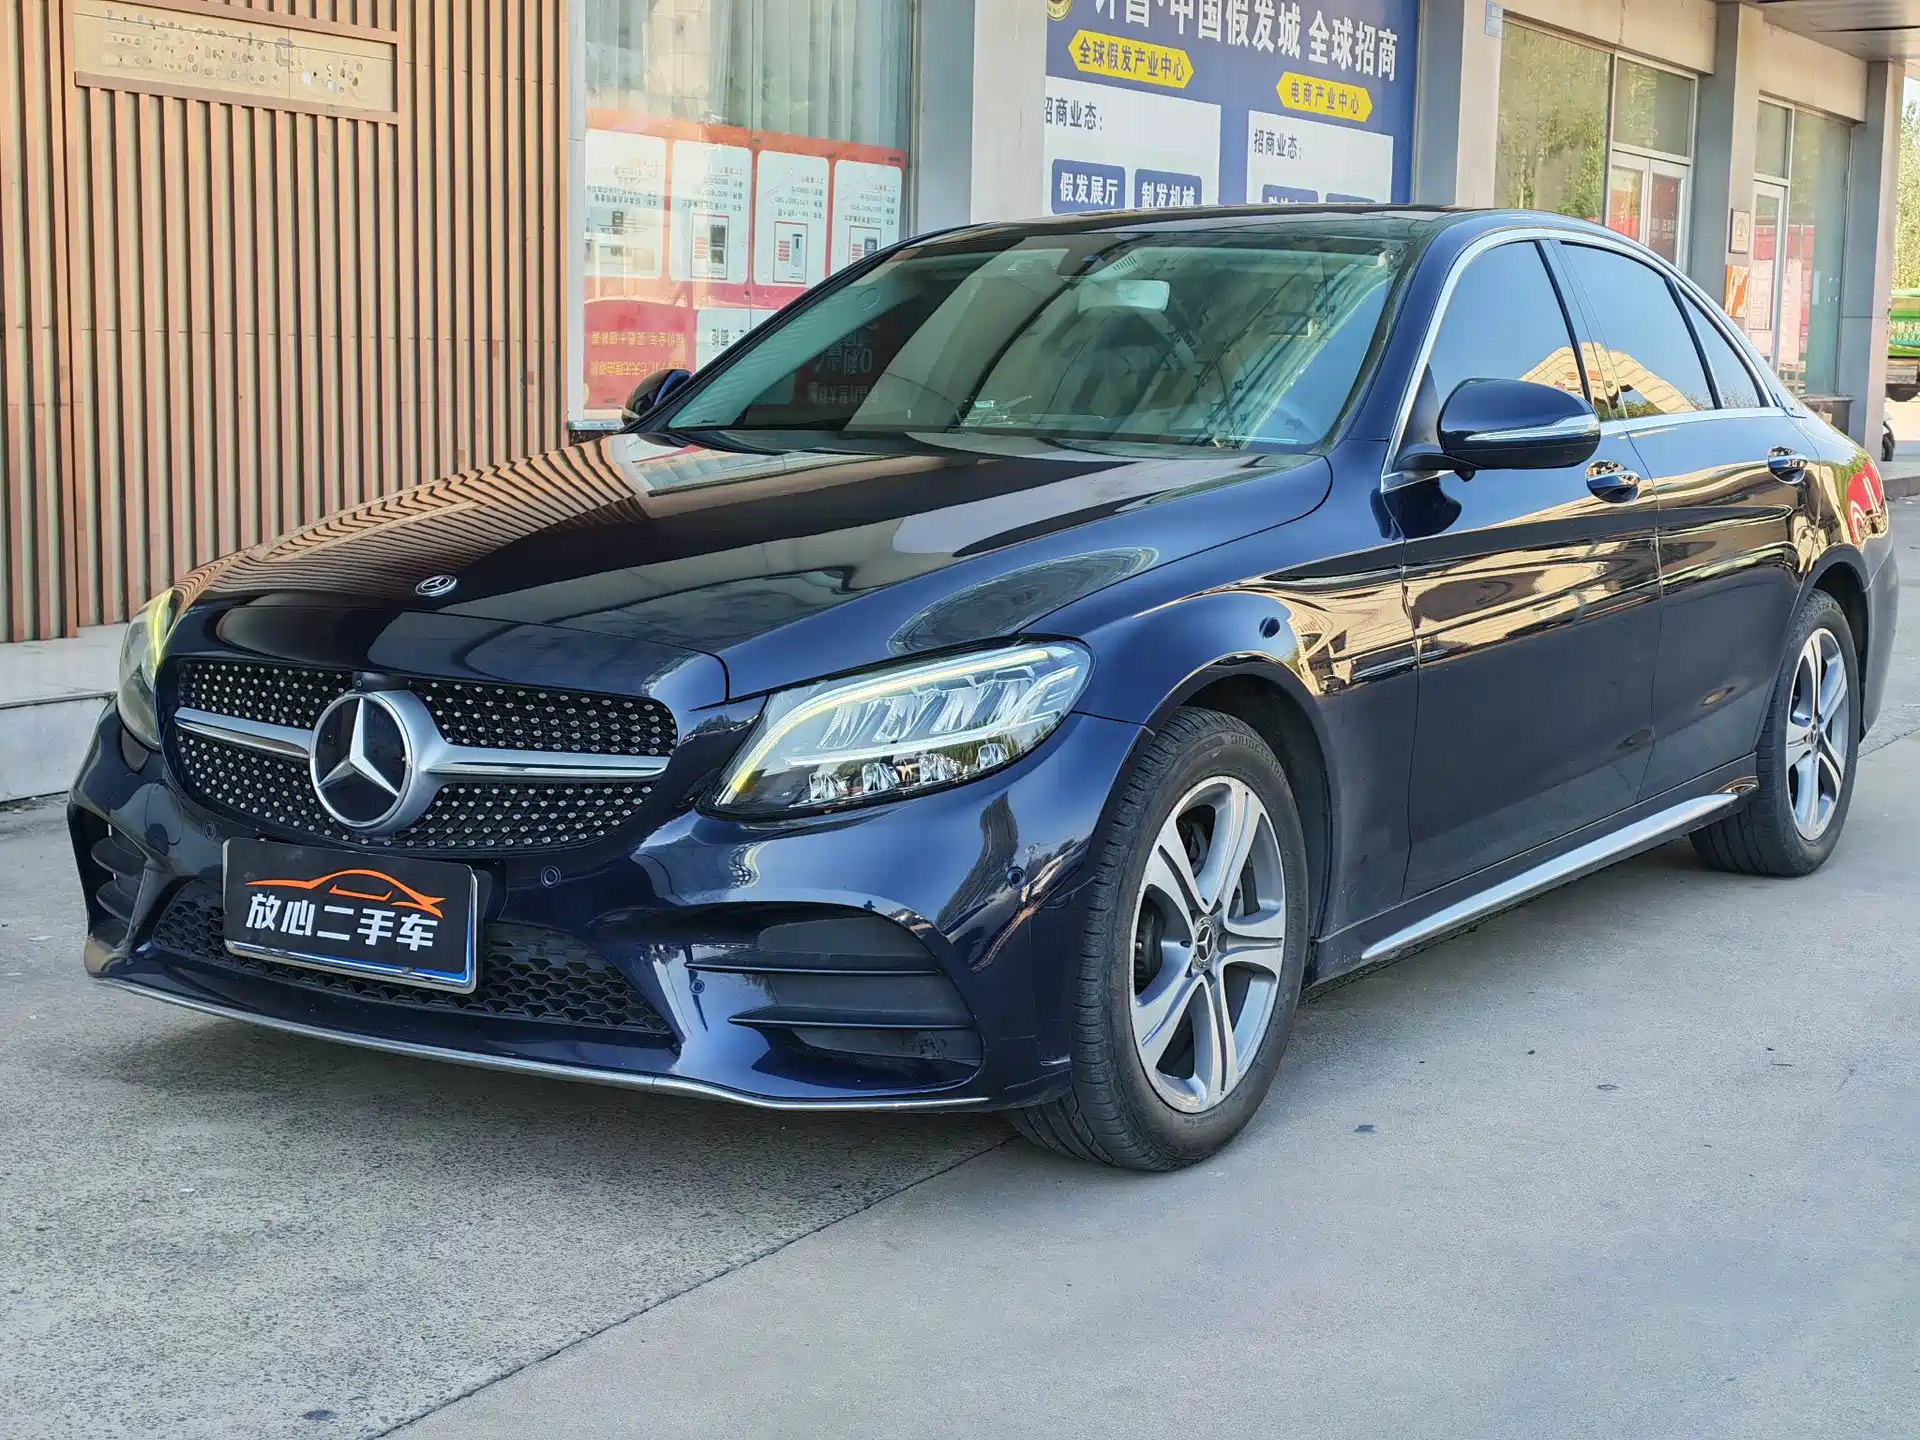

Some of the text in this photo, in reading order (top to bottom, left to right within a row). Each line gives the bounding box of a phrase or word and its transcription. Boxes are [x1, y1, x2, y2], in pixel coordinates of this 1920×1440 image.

[1078, 35, 1185, 82] 全球假发产业中心
[1308, 10, 1398, 81] 全球招商
[1290, 80, 1360, 115] 电商产业中心
[1060, 170, 1119, 206] 假发展厅
[245, 892, 439, 951] 放心二手车
